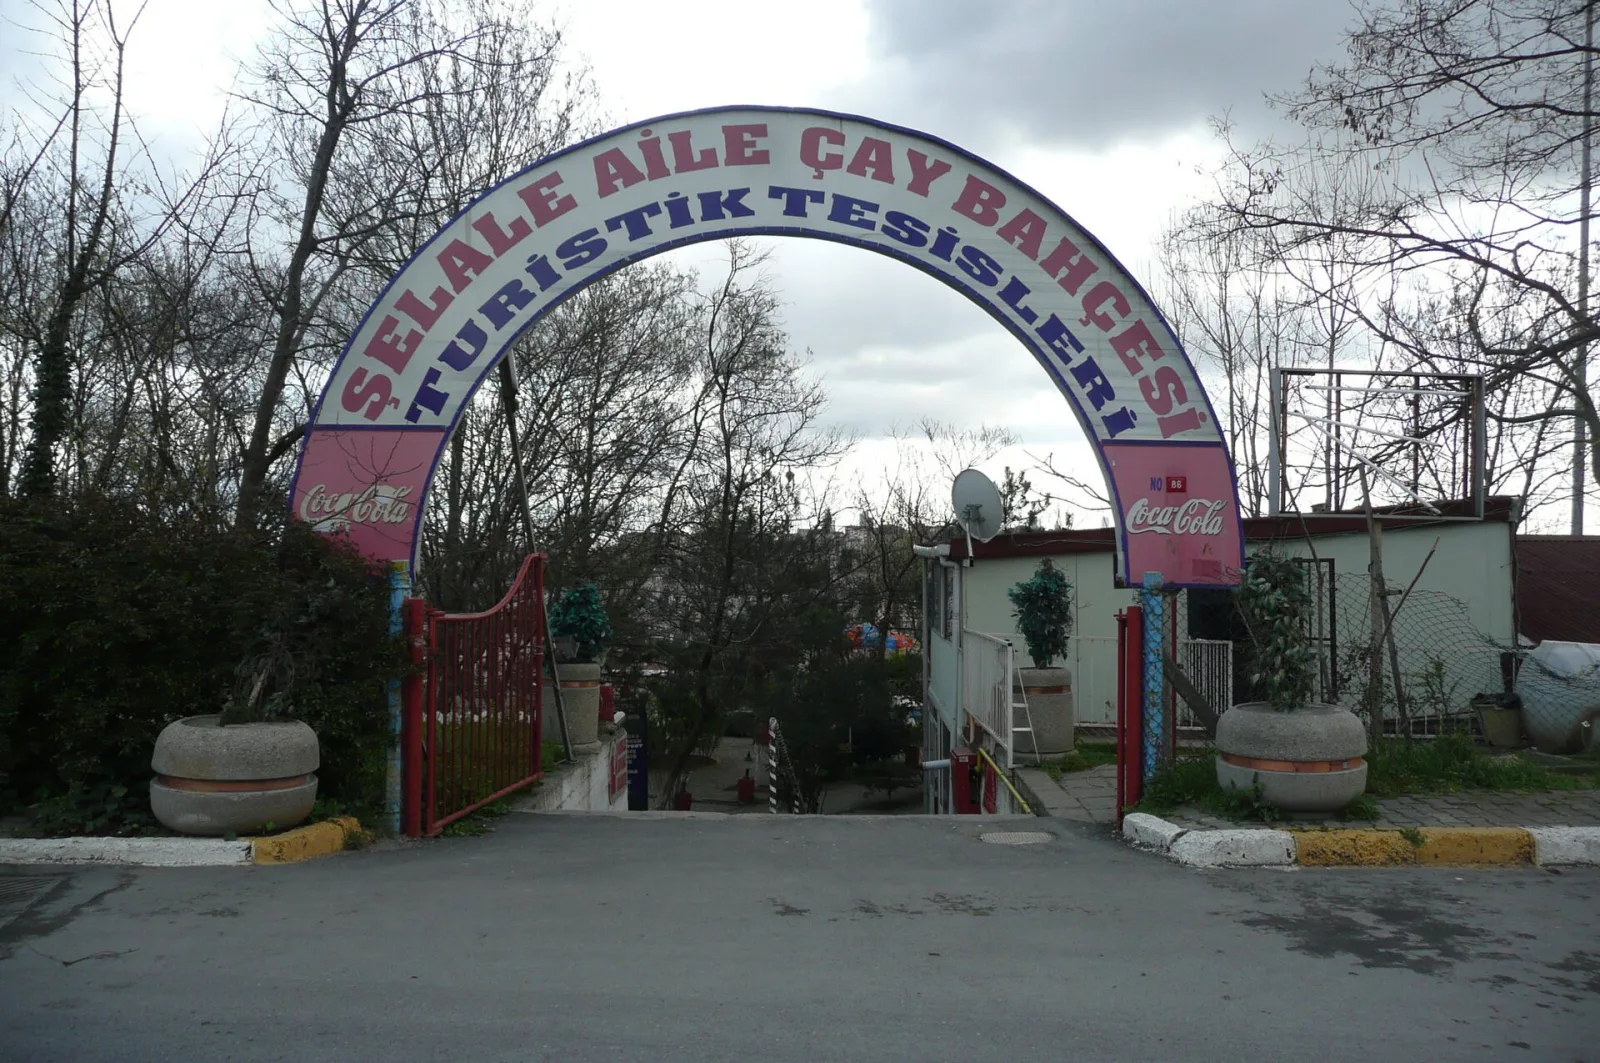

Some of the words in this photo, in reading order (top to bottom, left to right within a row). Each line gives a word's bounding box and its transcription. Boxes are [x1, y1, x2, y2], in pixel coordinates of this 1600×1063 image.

[341, 171, 578, 421] ŞELALE
[800, 126, 952, 198] ÇAY
[1150, 476, 1162, 491] NO
[1126, 498, 1227, 535] Coca-Cola
